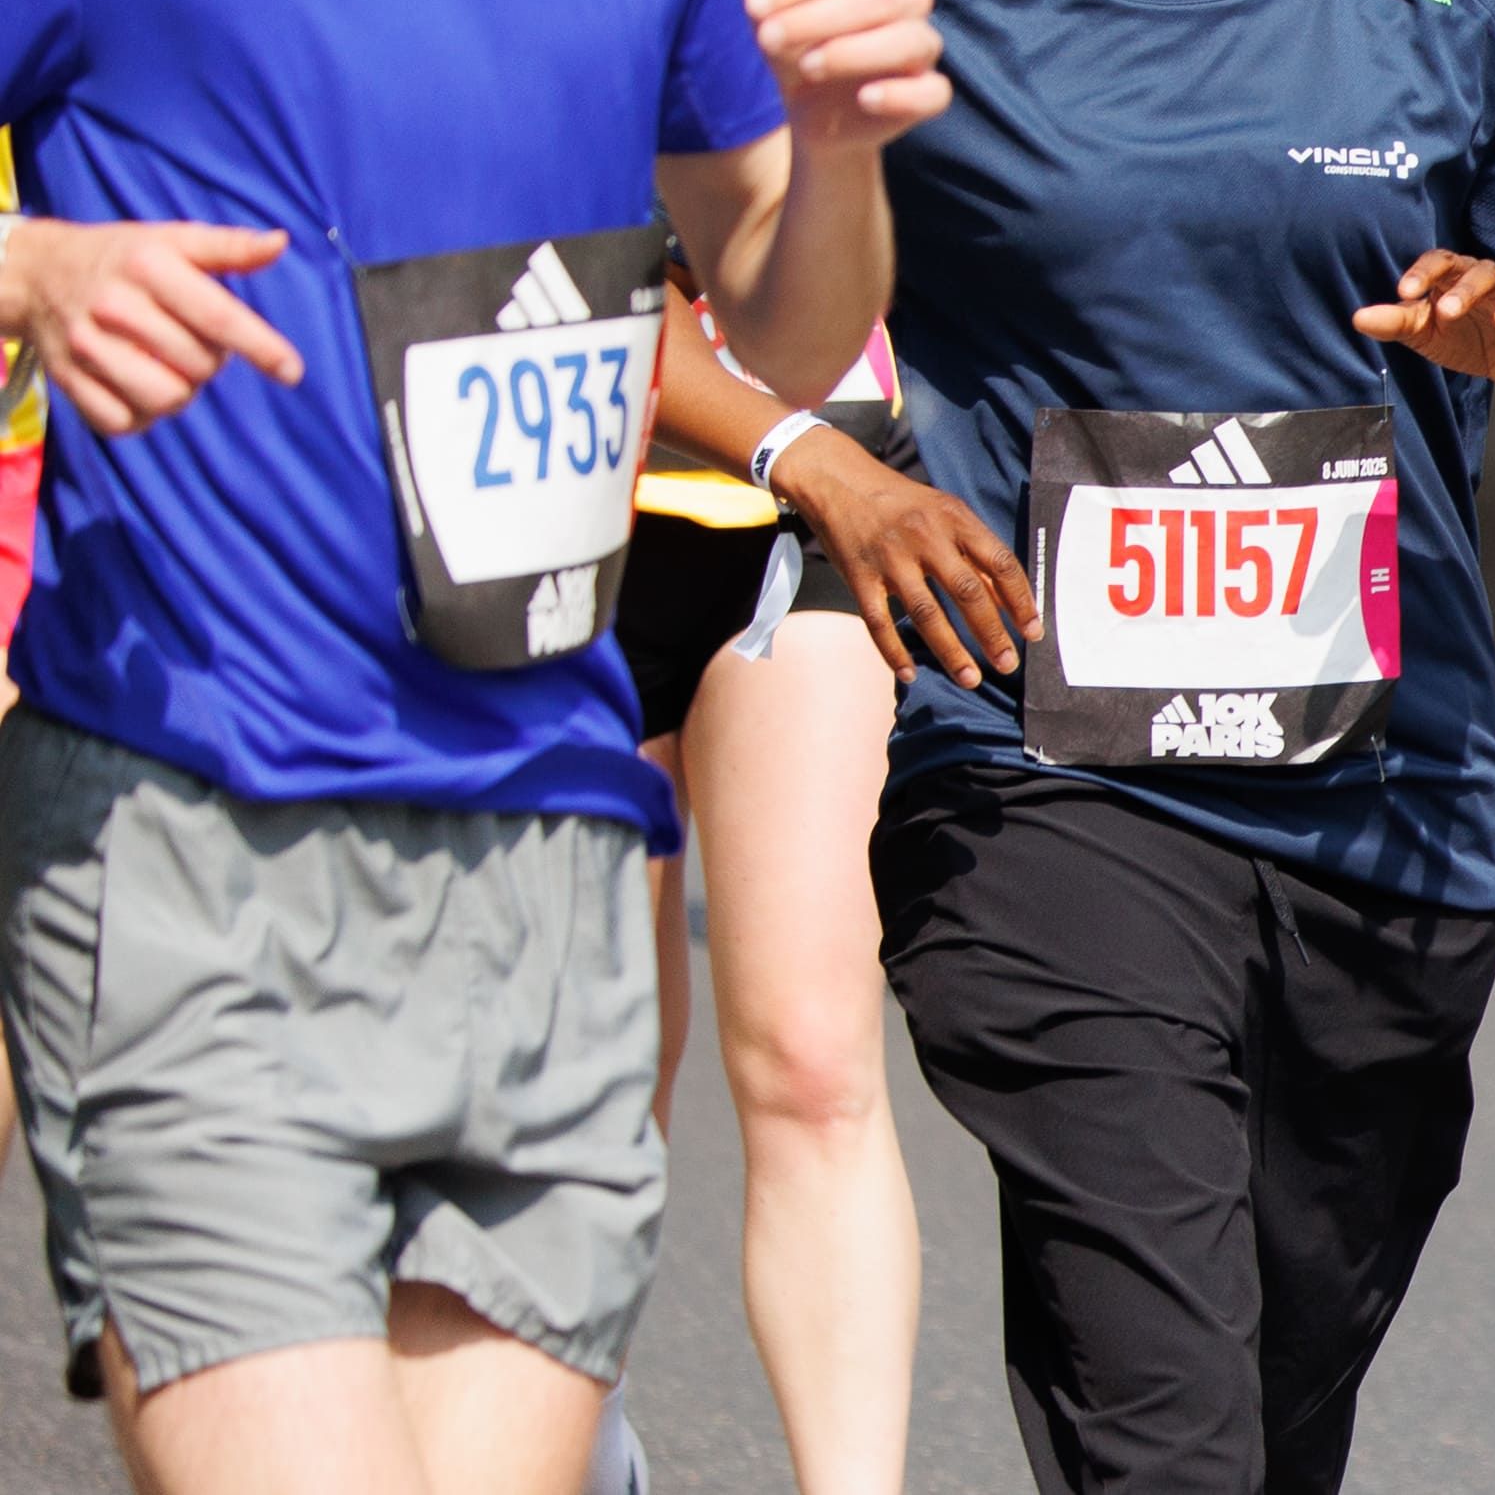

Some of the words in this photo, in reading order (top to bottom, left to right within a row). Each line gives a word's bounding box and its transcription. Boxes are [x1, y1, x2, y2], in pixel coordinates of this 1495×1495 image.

[1288, 146, 1380, 167] VINCI
[458, 347, 629, 488] 2933
[1322, 461, 1332, 480] 8
[1332, 459, 1360, 479] JUIN
[1360, 457, 1388, 477] 2025
[1106, 507, 1319, 618] 51157
[1198, 693, 1279, 727] 10K
[1151, 723, 1285, 759] PARIS
